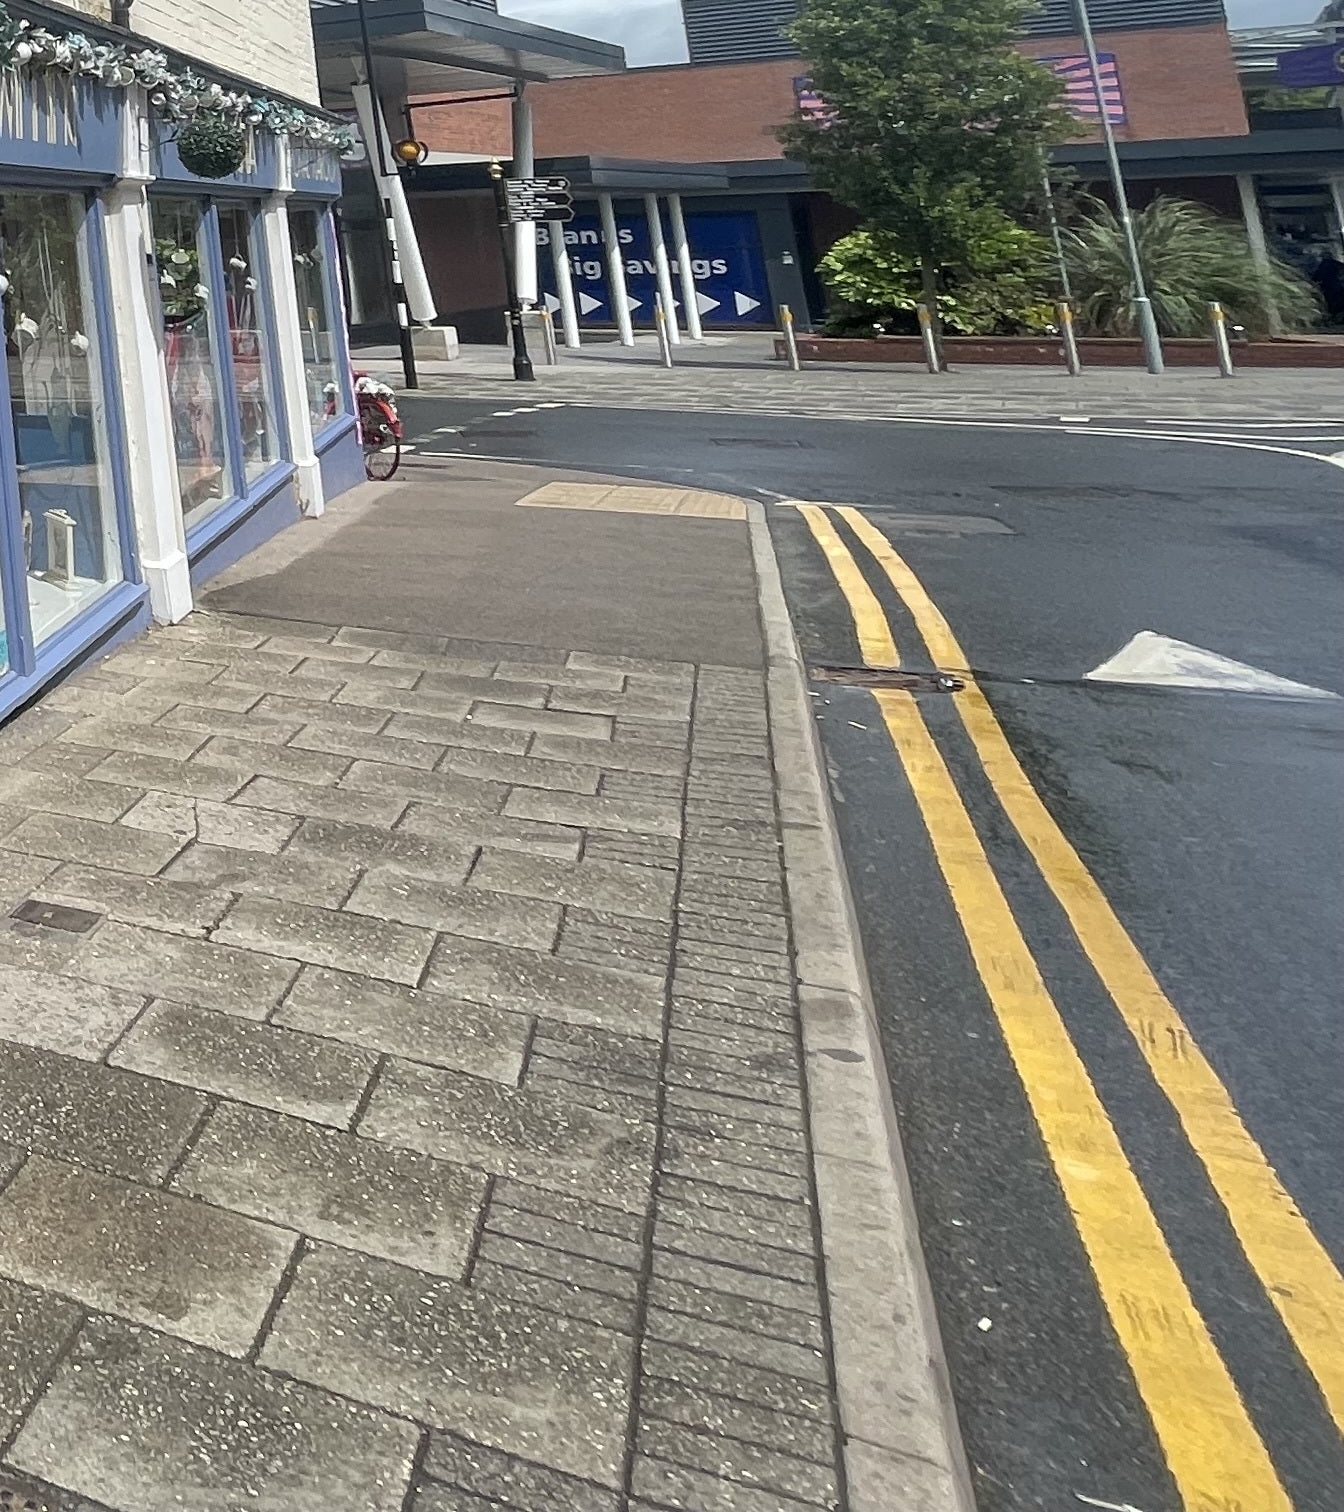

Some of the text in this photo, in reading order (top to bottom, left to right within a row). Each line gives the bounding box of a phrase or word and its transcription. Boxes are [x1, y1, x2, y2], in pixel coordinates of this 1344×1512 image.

[535, 227, 634, 245] Bans
[568, 255, 728, 280] ig avgs
